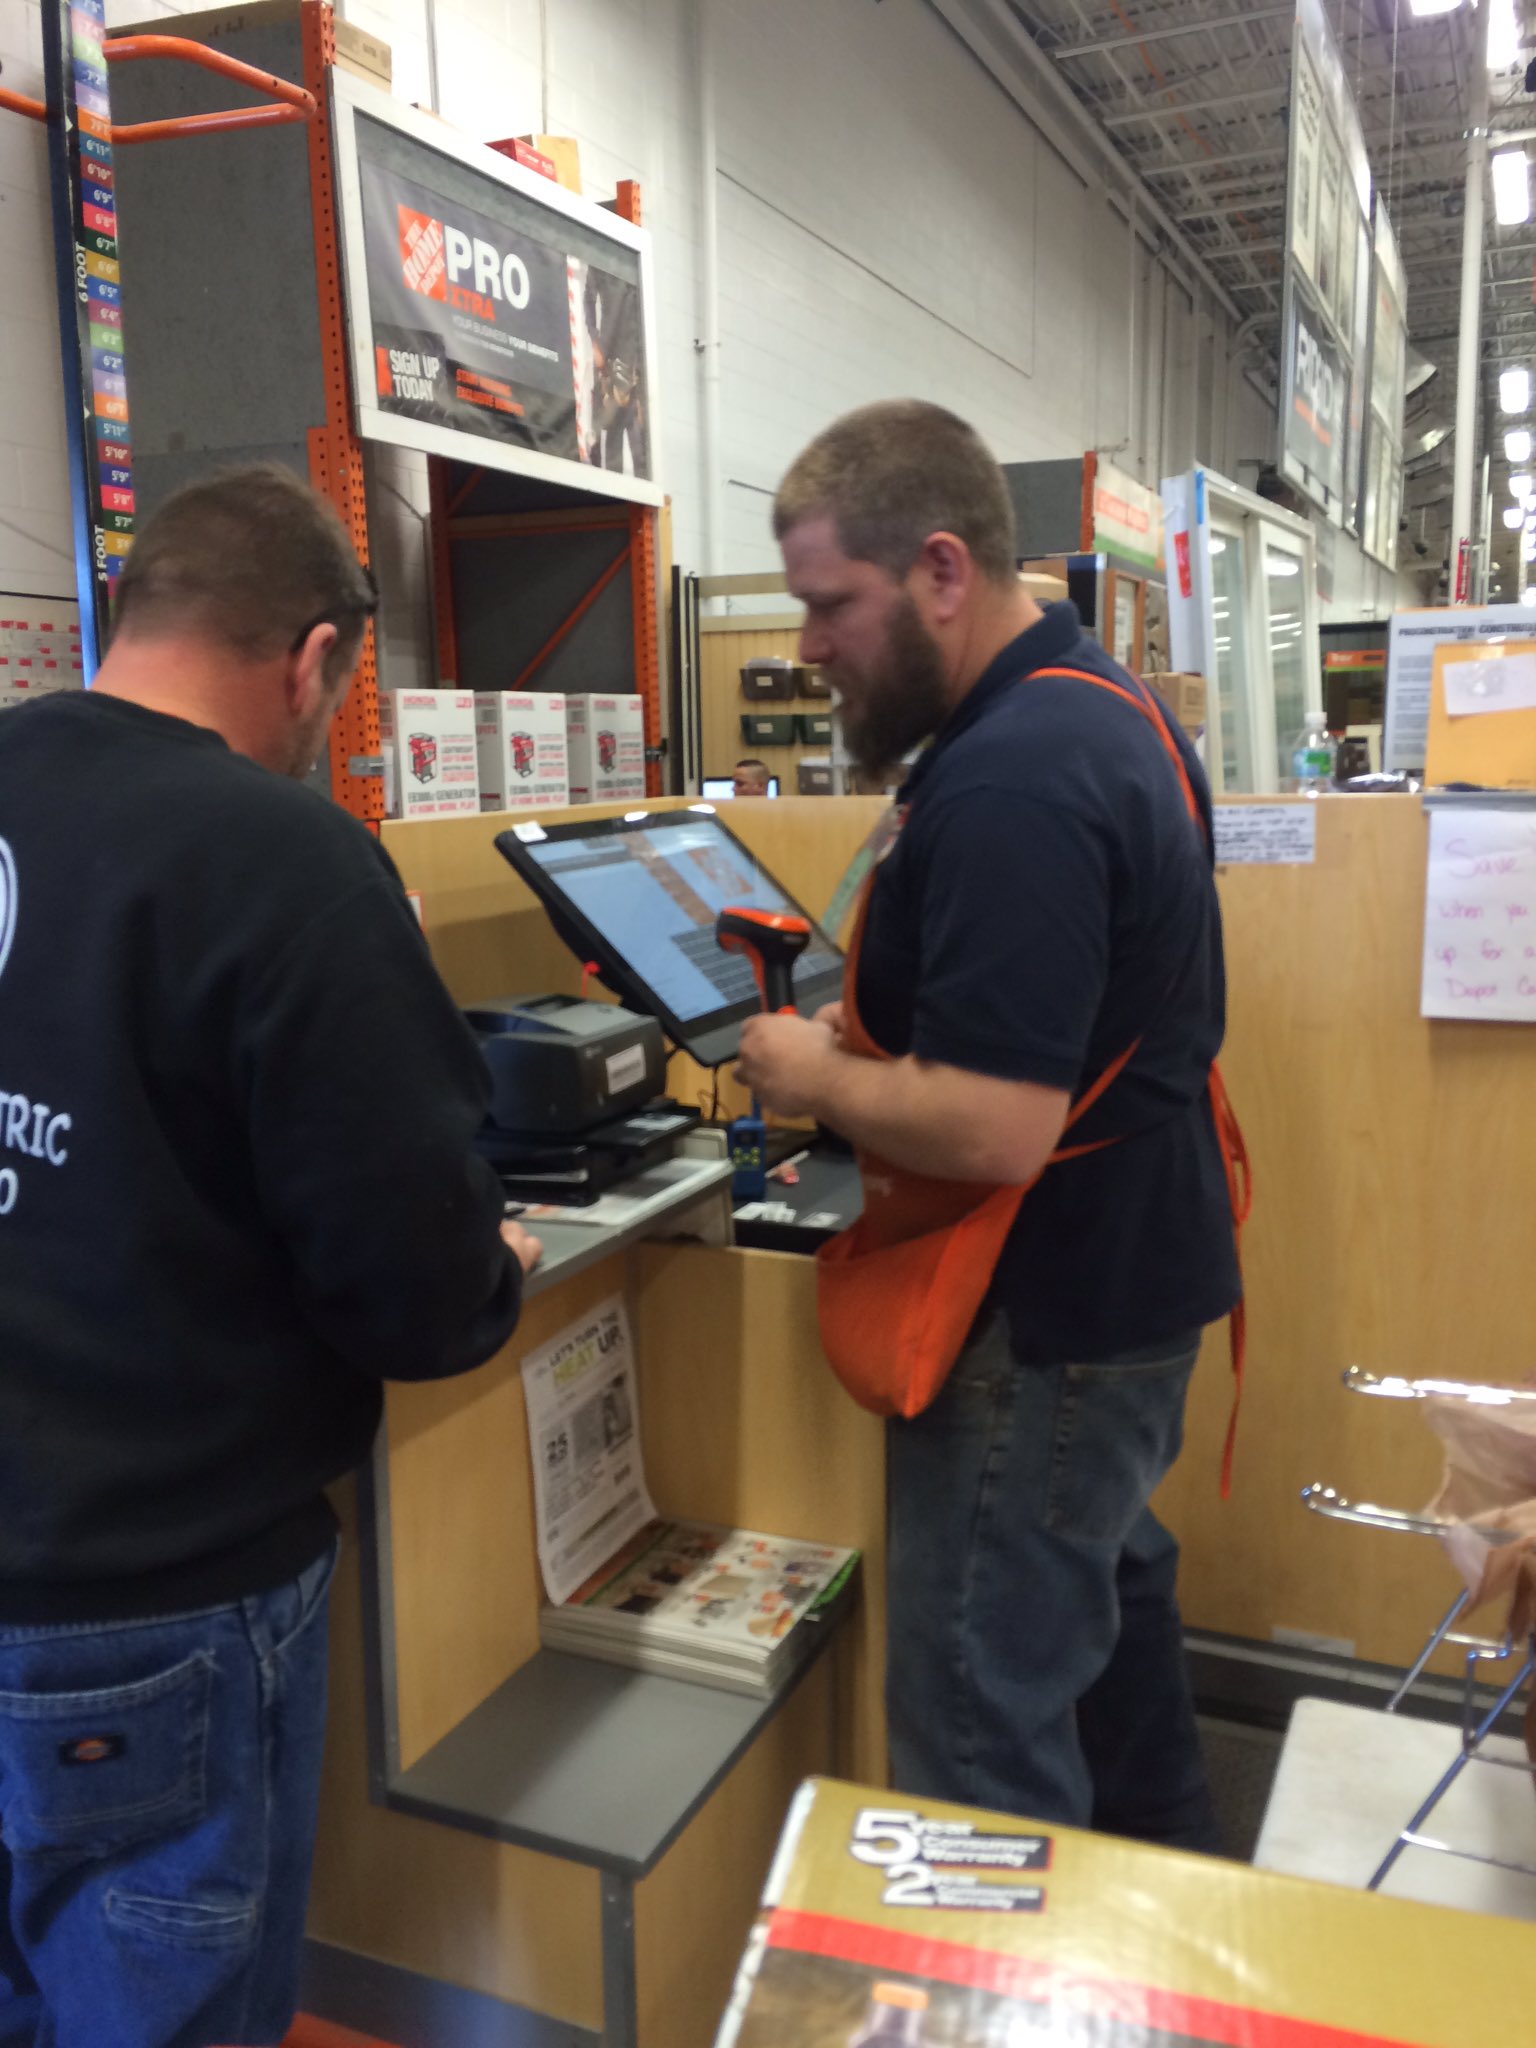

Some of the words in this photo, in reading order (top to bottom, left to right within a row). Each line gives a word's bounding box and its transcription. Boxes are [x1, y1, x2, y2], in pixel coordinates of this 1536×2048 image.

[86, 139, 111, 157] 6'11"
[87, 163, 112, 181] 6'10"
[93, 189, 113, 204] 6'9"
[95, 213, 114, 228] 6'8"
[96, 237, 116, 251] 6'7"
[75, 241, 88, 289] FOOT
[444, 224, 530, 310] PRO
[79, 291, 89, 303] 6
[103, 355, 122, 369] 6'2"
[388, 349, 421, 378] SIGN
[422, 353, 441, 379] UP
[392, 374, 435, 402] TODAY
[103, 422, 127, 437] 5'11"
[104, 445, 128, 459] 5'10"
[111, 469, 129, 483] 5'9"
[114, 515, 133, 528] 5'7"
[94, 524, 107, 569] FOOT
[97, 571, 108, 581] 5
[436, 787, 476, 802] GENERATOR
[1446, 837, 1522, 879] Save
[850, 1808, 922, 1866] 5
[882, 1863, 933, 1905] 2
